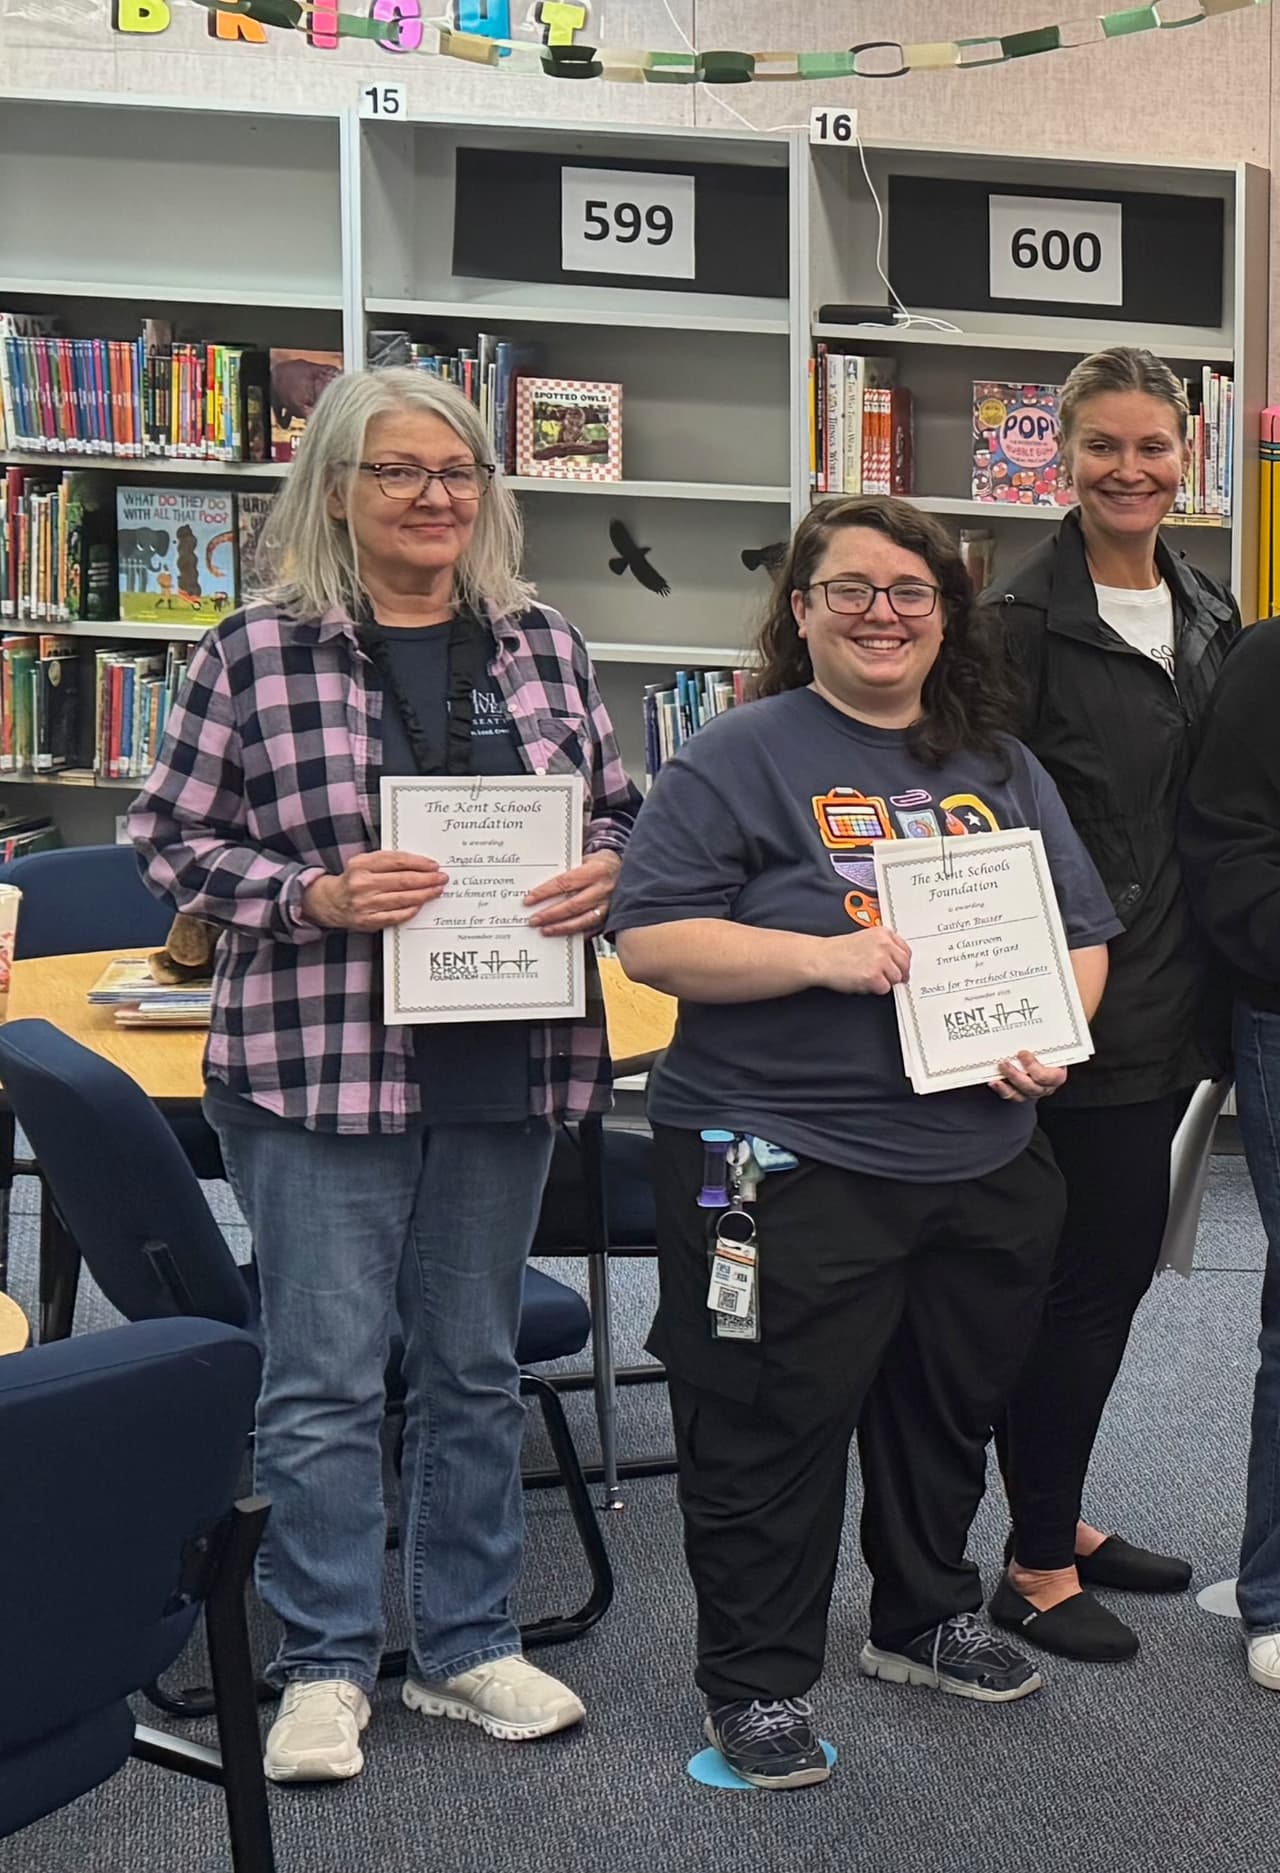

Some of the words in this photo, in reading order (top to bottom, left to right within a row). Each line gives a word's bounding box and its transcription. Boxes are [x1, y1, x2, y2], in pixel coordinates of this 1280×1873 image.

[365, 88, 400, 114] 15
[815, 113, 852, 142] 16
[583, 200, 674, 246] 599
[1011, 227, 1102, 272] 600
[1003, 415, 1055, 440] POP!
[124, 496, 157, 506] WHAT
[159, 496, 176, 506] DO
[180, 495, 205, 508] THEY
[208, 499, 225, 509] DO
[124, 508, 150, 520] WITH
[154, 508, 170, 520] ALL
[173, 509, 197, 522] THAT
[200, 511, 229, 524] POO?
[425, 802, 449, 813] The
[454, 802, 488, 813] Kent
[493, 801, 542, 813] Schools
[442, 818, 523, 832] Foundation
[911, 872, 930, 886] The
[968, 862, 1010, 876] Schools
[928, 880, 998, 901] Foundation
[470, 916, 485, 927] for
[430, 951, 478, 966] KENT
[920, 984, 945, 995] Books
[948, 980, 961, 993] for
[964, 972, 1007, 987] Preschool
[944, 1007, 985, 1029] KENT
